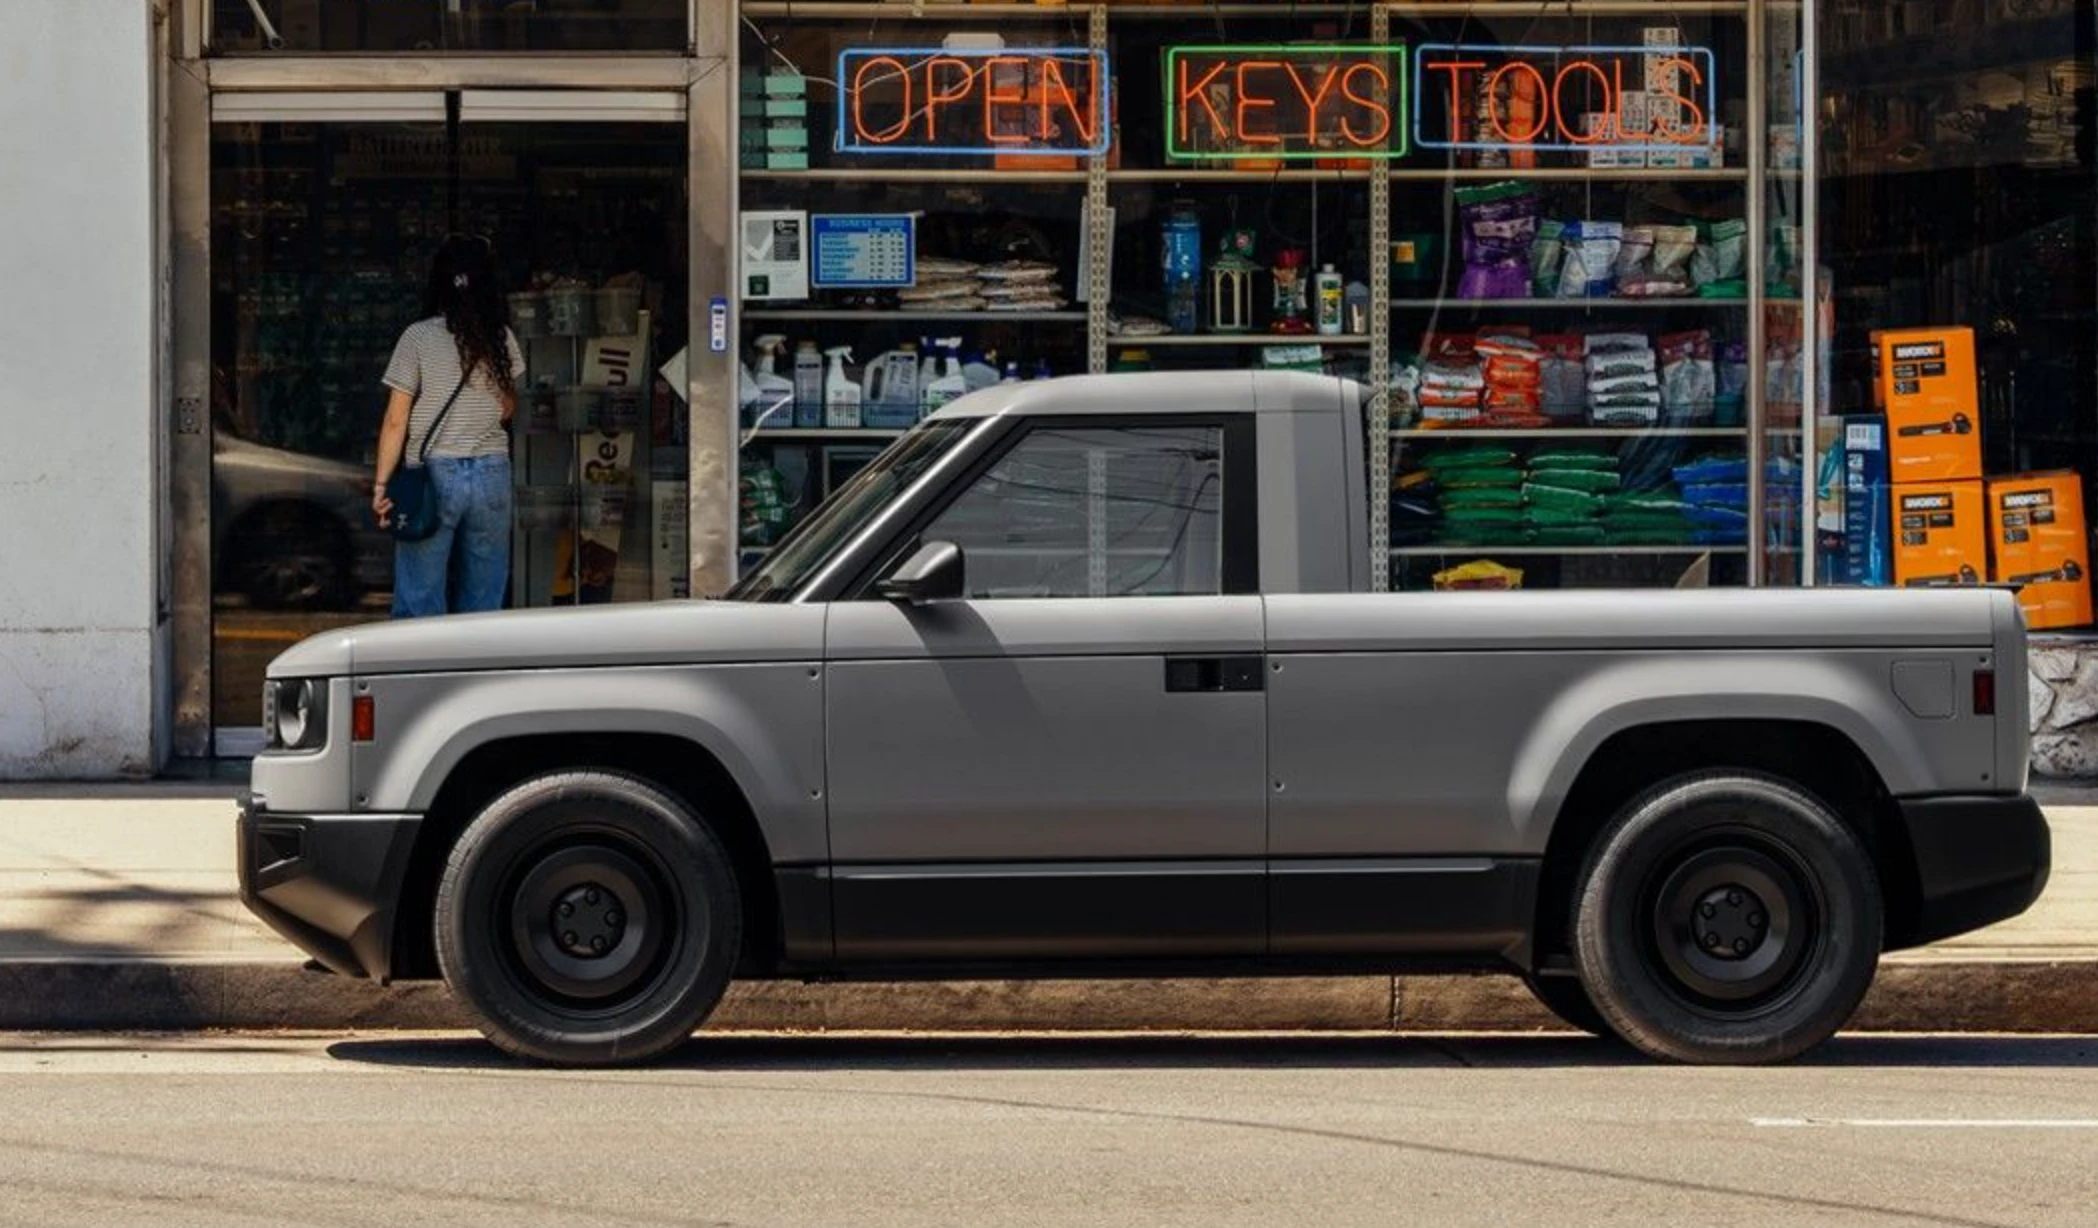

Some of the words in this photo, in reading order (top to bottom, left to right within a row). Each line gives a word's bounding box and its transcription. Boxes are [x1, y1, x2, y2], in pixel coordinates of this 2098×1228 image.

[854, 56, 1098, 143] OPEN
[1179, 60, 1391, 145] KEYS
[1426, 58, 1703, 144] TOOLS
